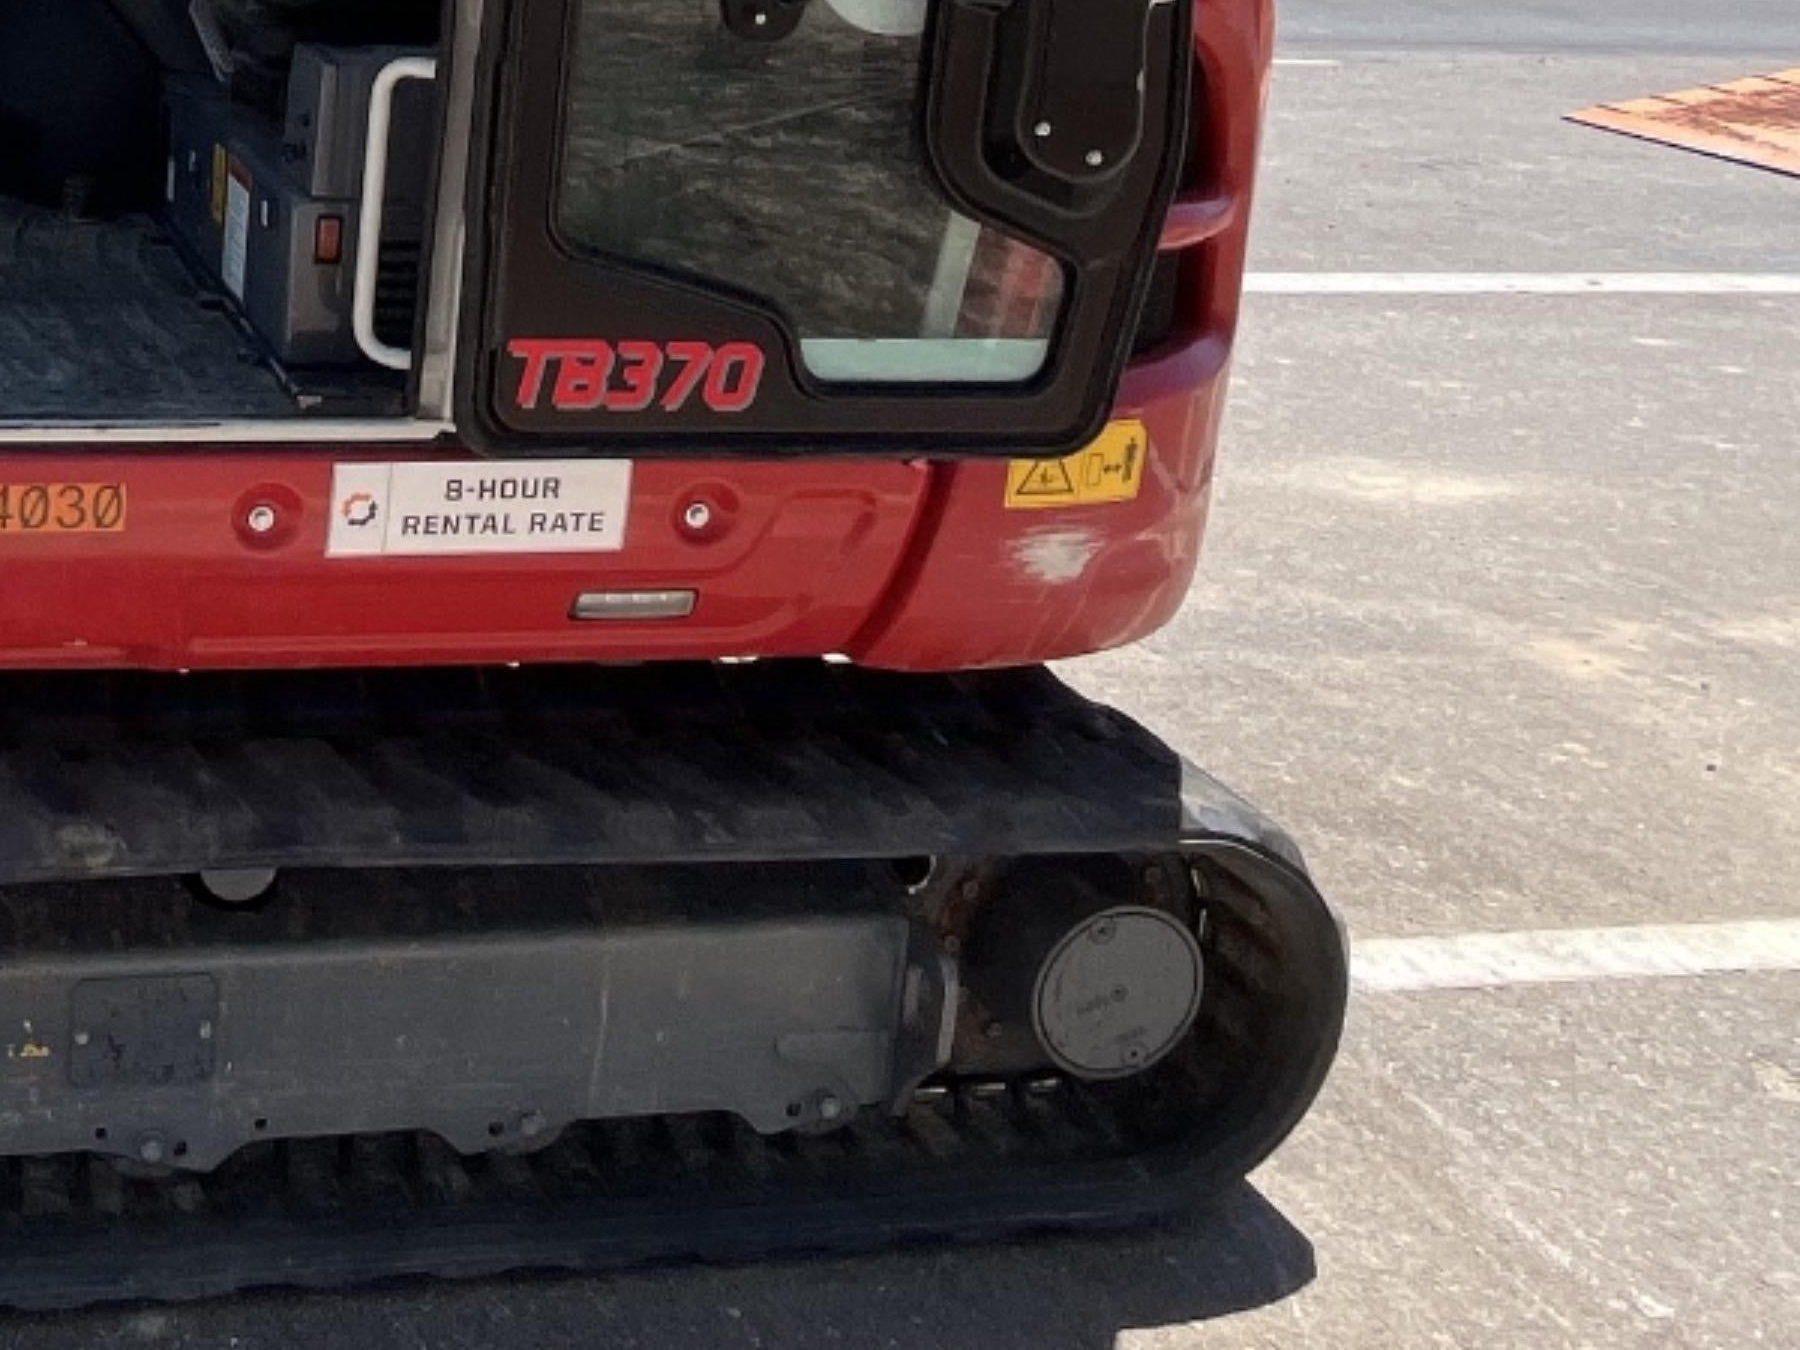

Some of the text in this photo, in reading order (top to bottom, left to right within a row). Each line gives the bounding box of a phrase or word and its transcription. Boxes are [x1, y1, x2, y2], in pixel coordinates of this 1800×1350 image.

[506, 336, 766, 411] TB370
[444, 476, 562, 502] 8-HOUR
[400, 511, 606, 536] RENTAL RATE
